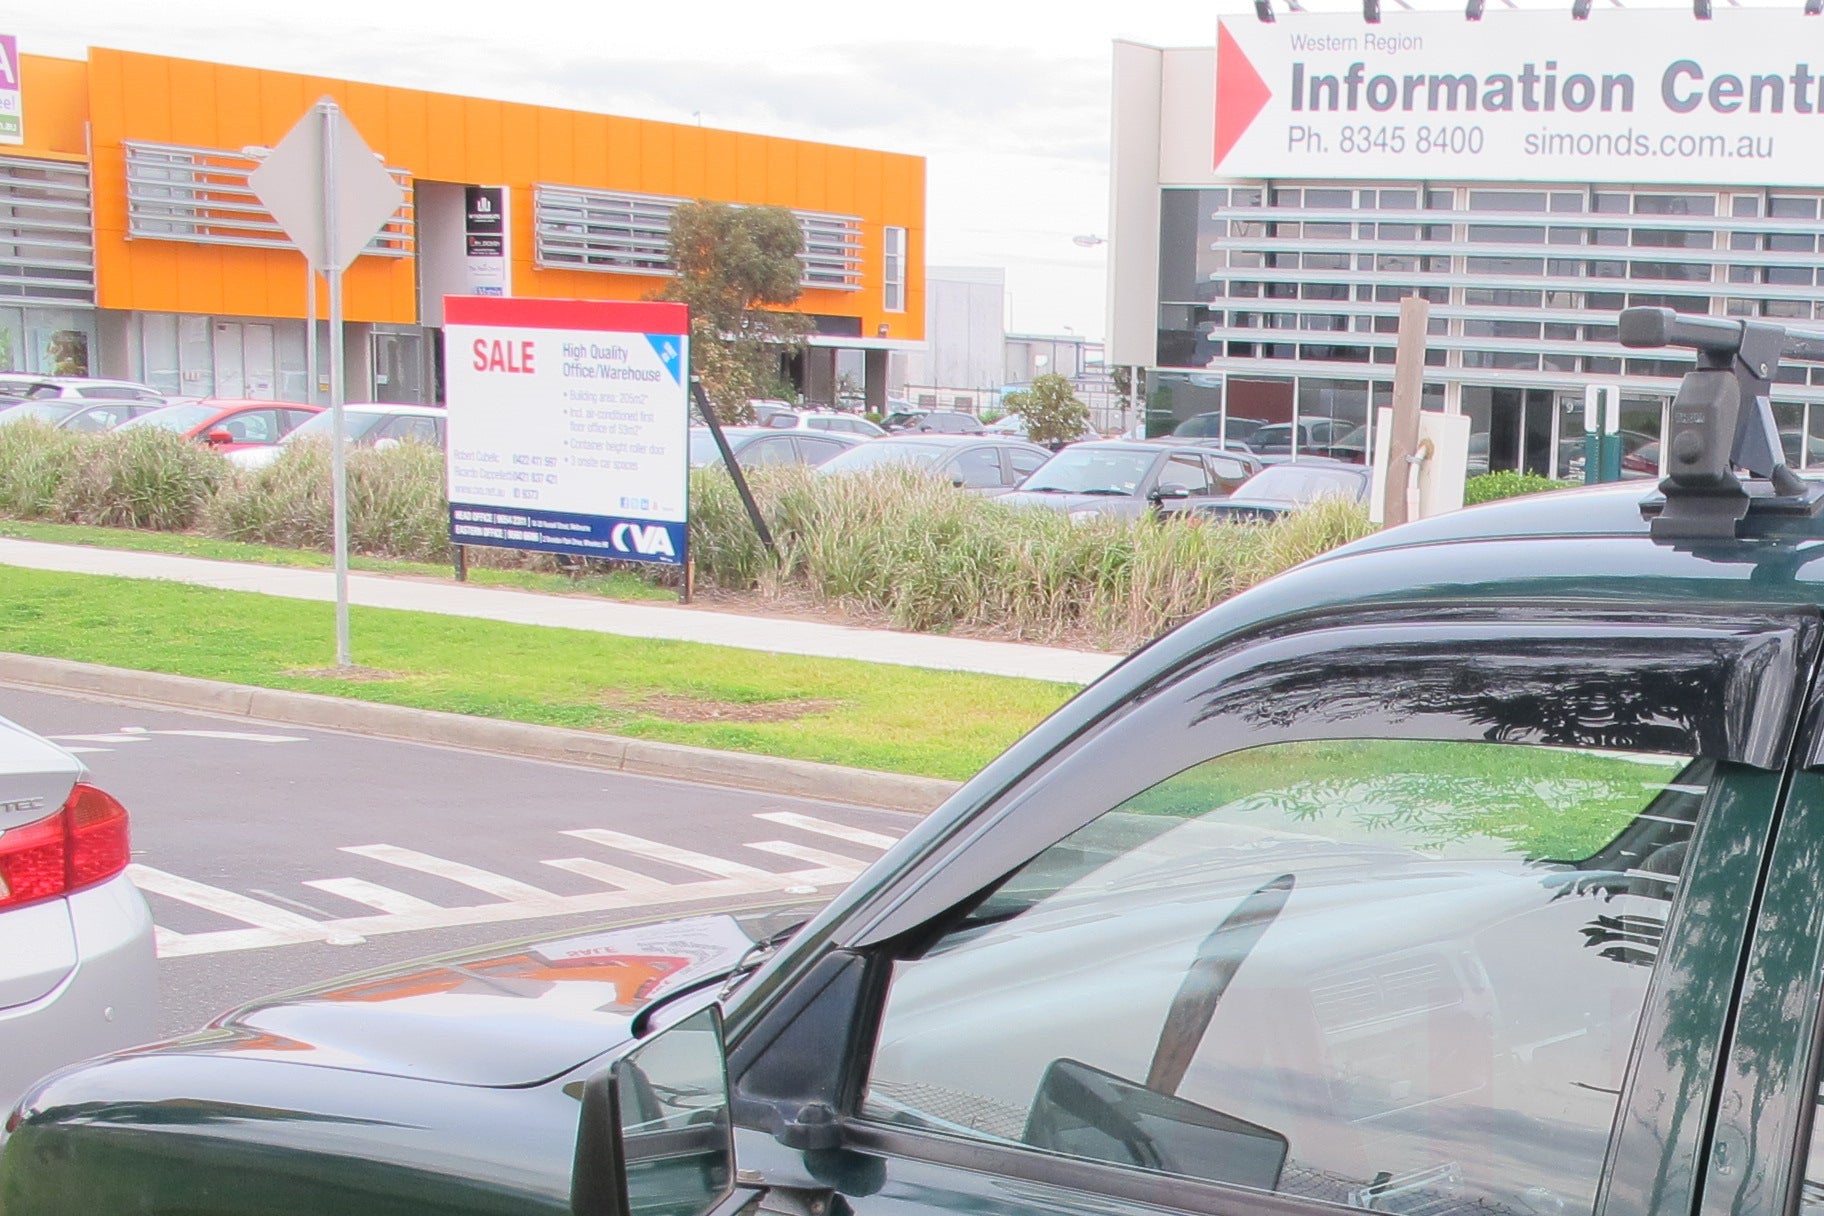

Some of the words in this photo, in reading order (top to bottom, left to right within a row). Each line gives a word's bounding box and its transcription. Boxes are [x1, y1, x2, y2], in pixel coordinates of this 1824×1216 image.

[1291, 34, 1357, 51] Western
[1364, 33, 1422, 54] Region
[1291, 61, 1634, 112] Information
[1288, 126, 1328, 153] Ph.
[1340, 125, 1405, 154] 8345
[1415, 126, 1484, 154] 8400
[1523, 127, 1773, 158] simonds.com.au
[473, 339, 535, 374] SALE
[563, 342, 588, 361] High
[590, 344, 628, 364] Quality
[563, 362, 661, 382] Office/Warehouse
[611, 523, 675, 556] CVA
